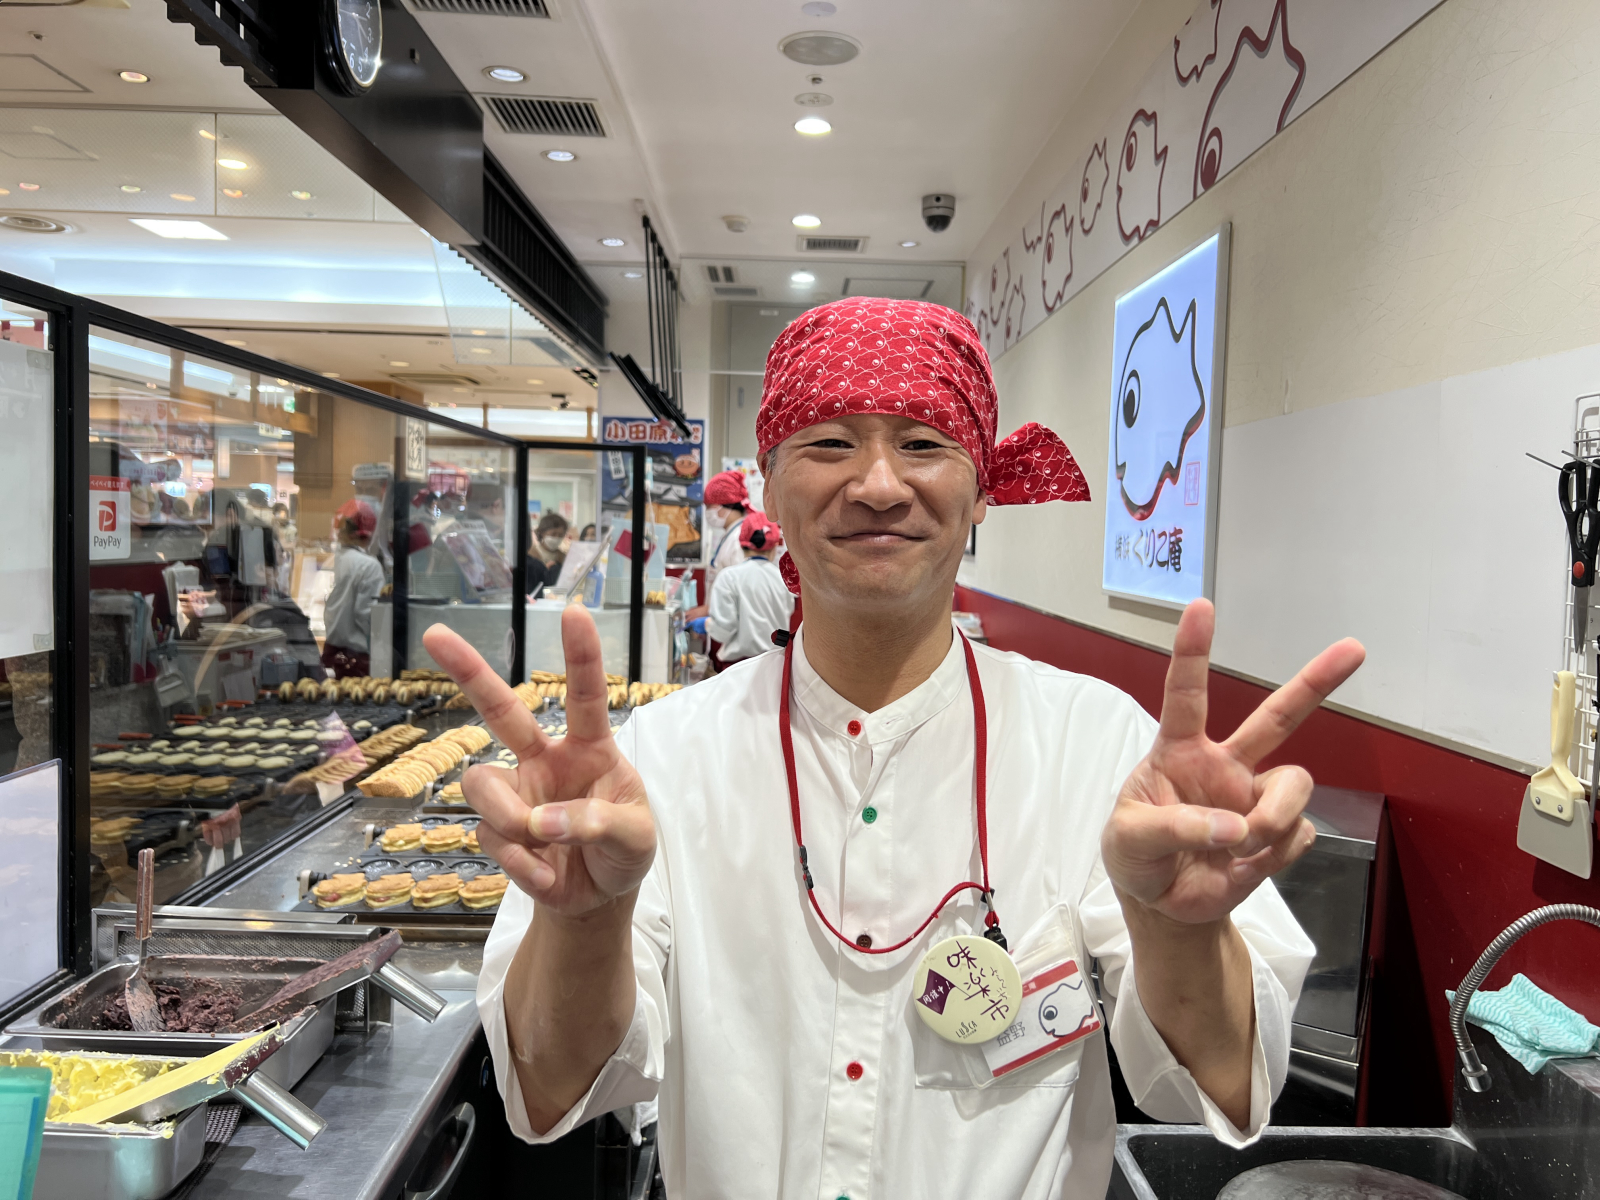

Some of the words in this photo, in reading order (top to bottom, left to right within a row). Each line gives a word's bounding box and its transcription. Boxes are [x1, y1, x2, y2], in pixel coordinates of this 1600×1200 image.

[349, 52, 355, 69] 6
[605, 419, 690, 444] 小田原
[93, 535, 122, 550] PayPay
[955, 1020, 978, 1038] LUSCA
